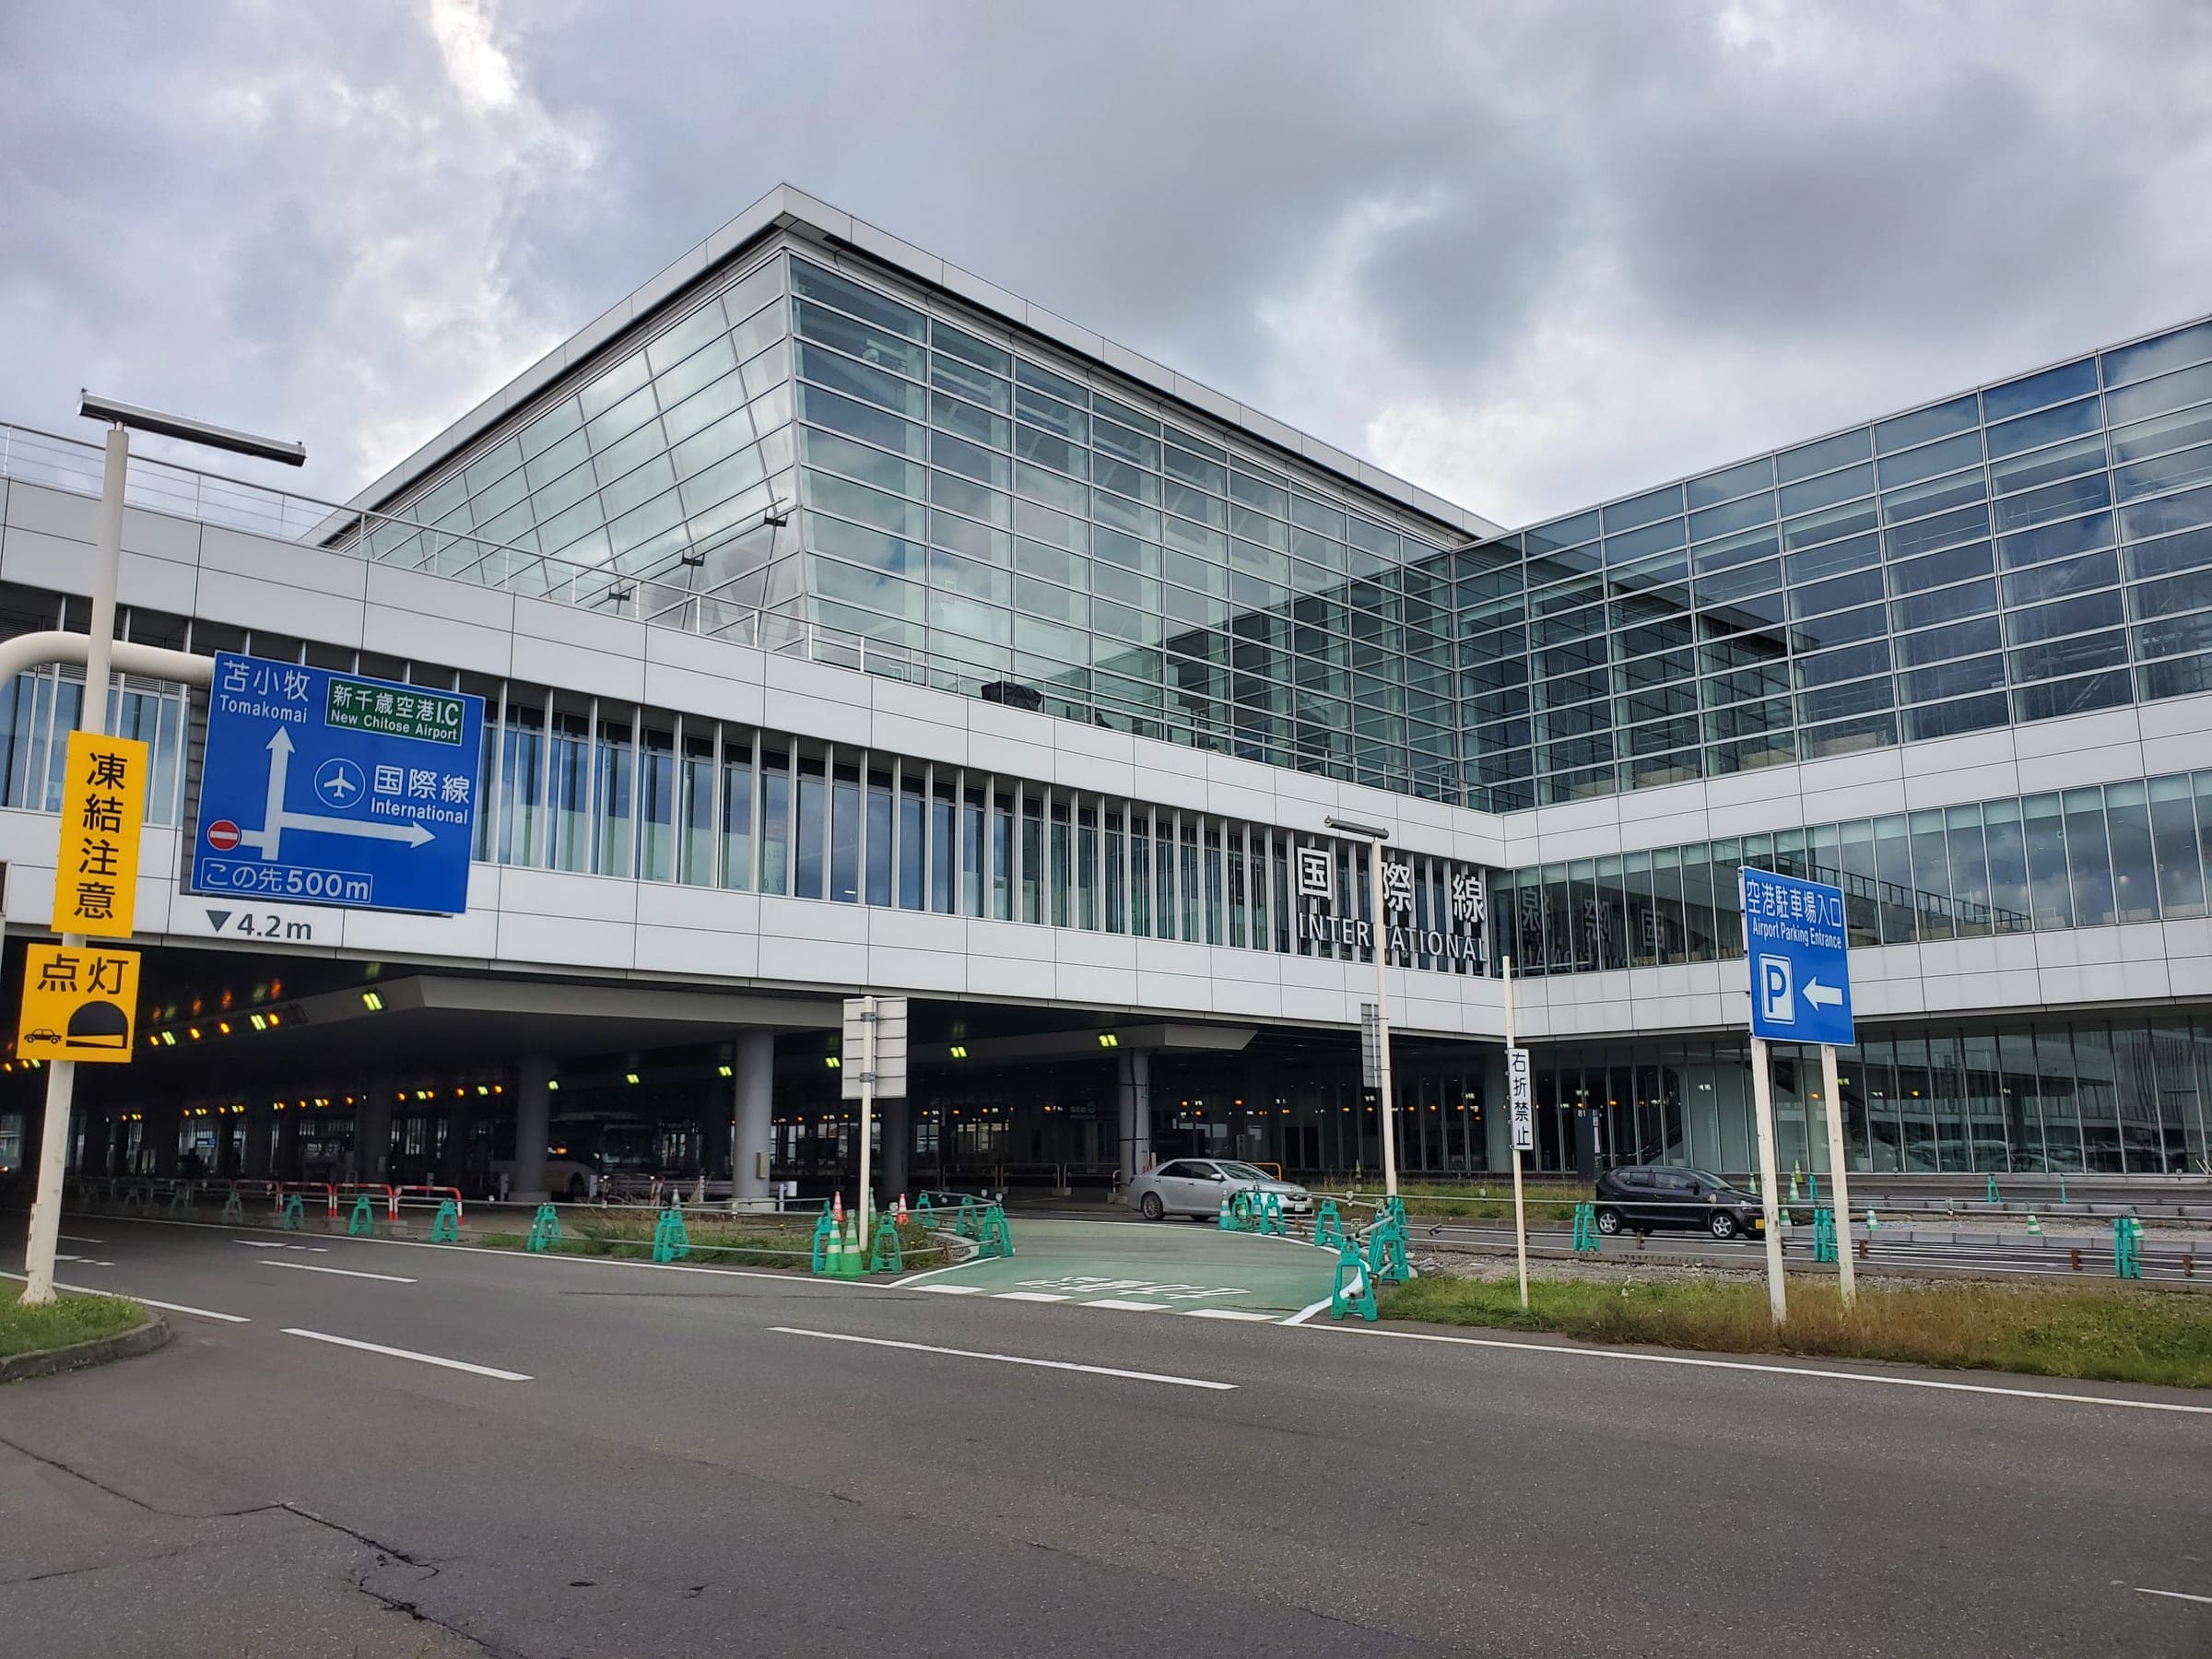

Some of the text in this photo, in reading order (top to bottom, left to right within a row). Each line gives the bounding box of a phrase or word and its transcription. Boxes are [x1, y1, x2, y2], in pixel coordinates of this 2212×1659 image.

[223, 661, 311, 702] 苫小牧
[220, 694, 308, 724] Tomakomai
[331, 710, 457, 740] New Chitose Airport
[373, 764, 471, 805] 国際線
[371, 797, 468, 824] International
[74, 751, 128, 920] 凍結注意
[206, 863, 369, 900] この先500m
[1298, 846, 1486, 924] 国際線
[1747, 878, 1842, 928] 空港駐車場入口
[1753, 917, 1841, 950] Airport Parking Entrance
[37, 953, 128, 995] 点灯
[1766, 964, 1786, 1013] P
[1511, 1052, 1531, 1147] 右折禁止
